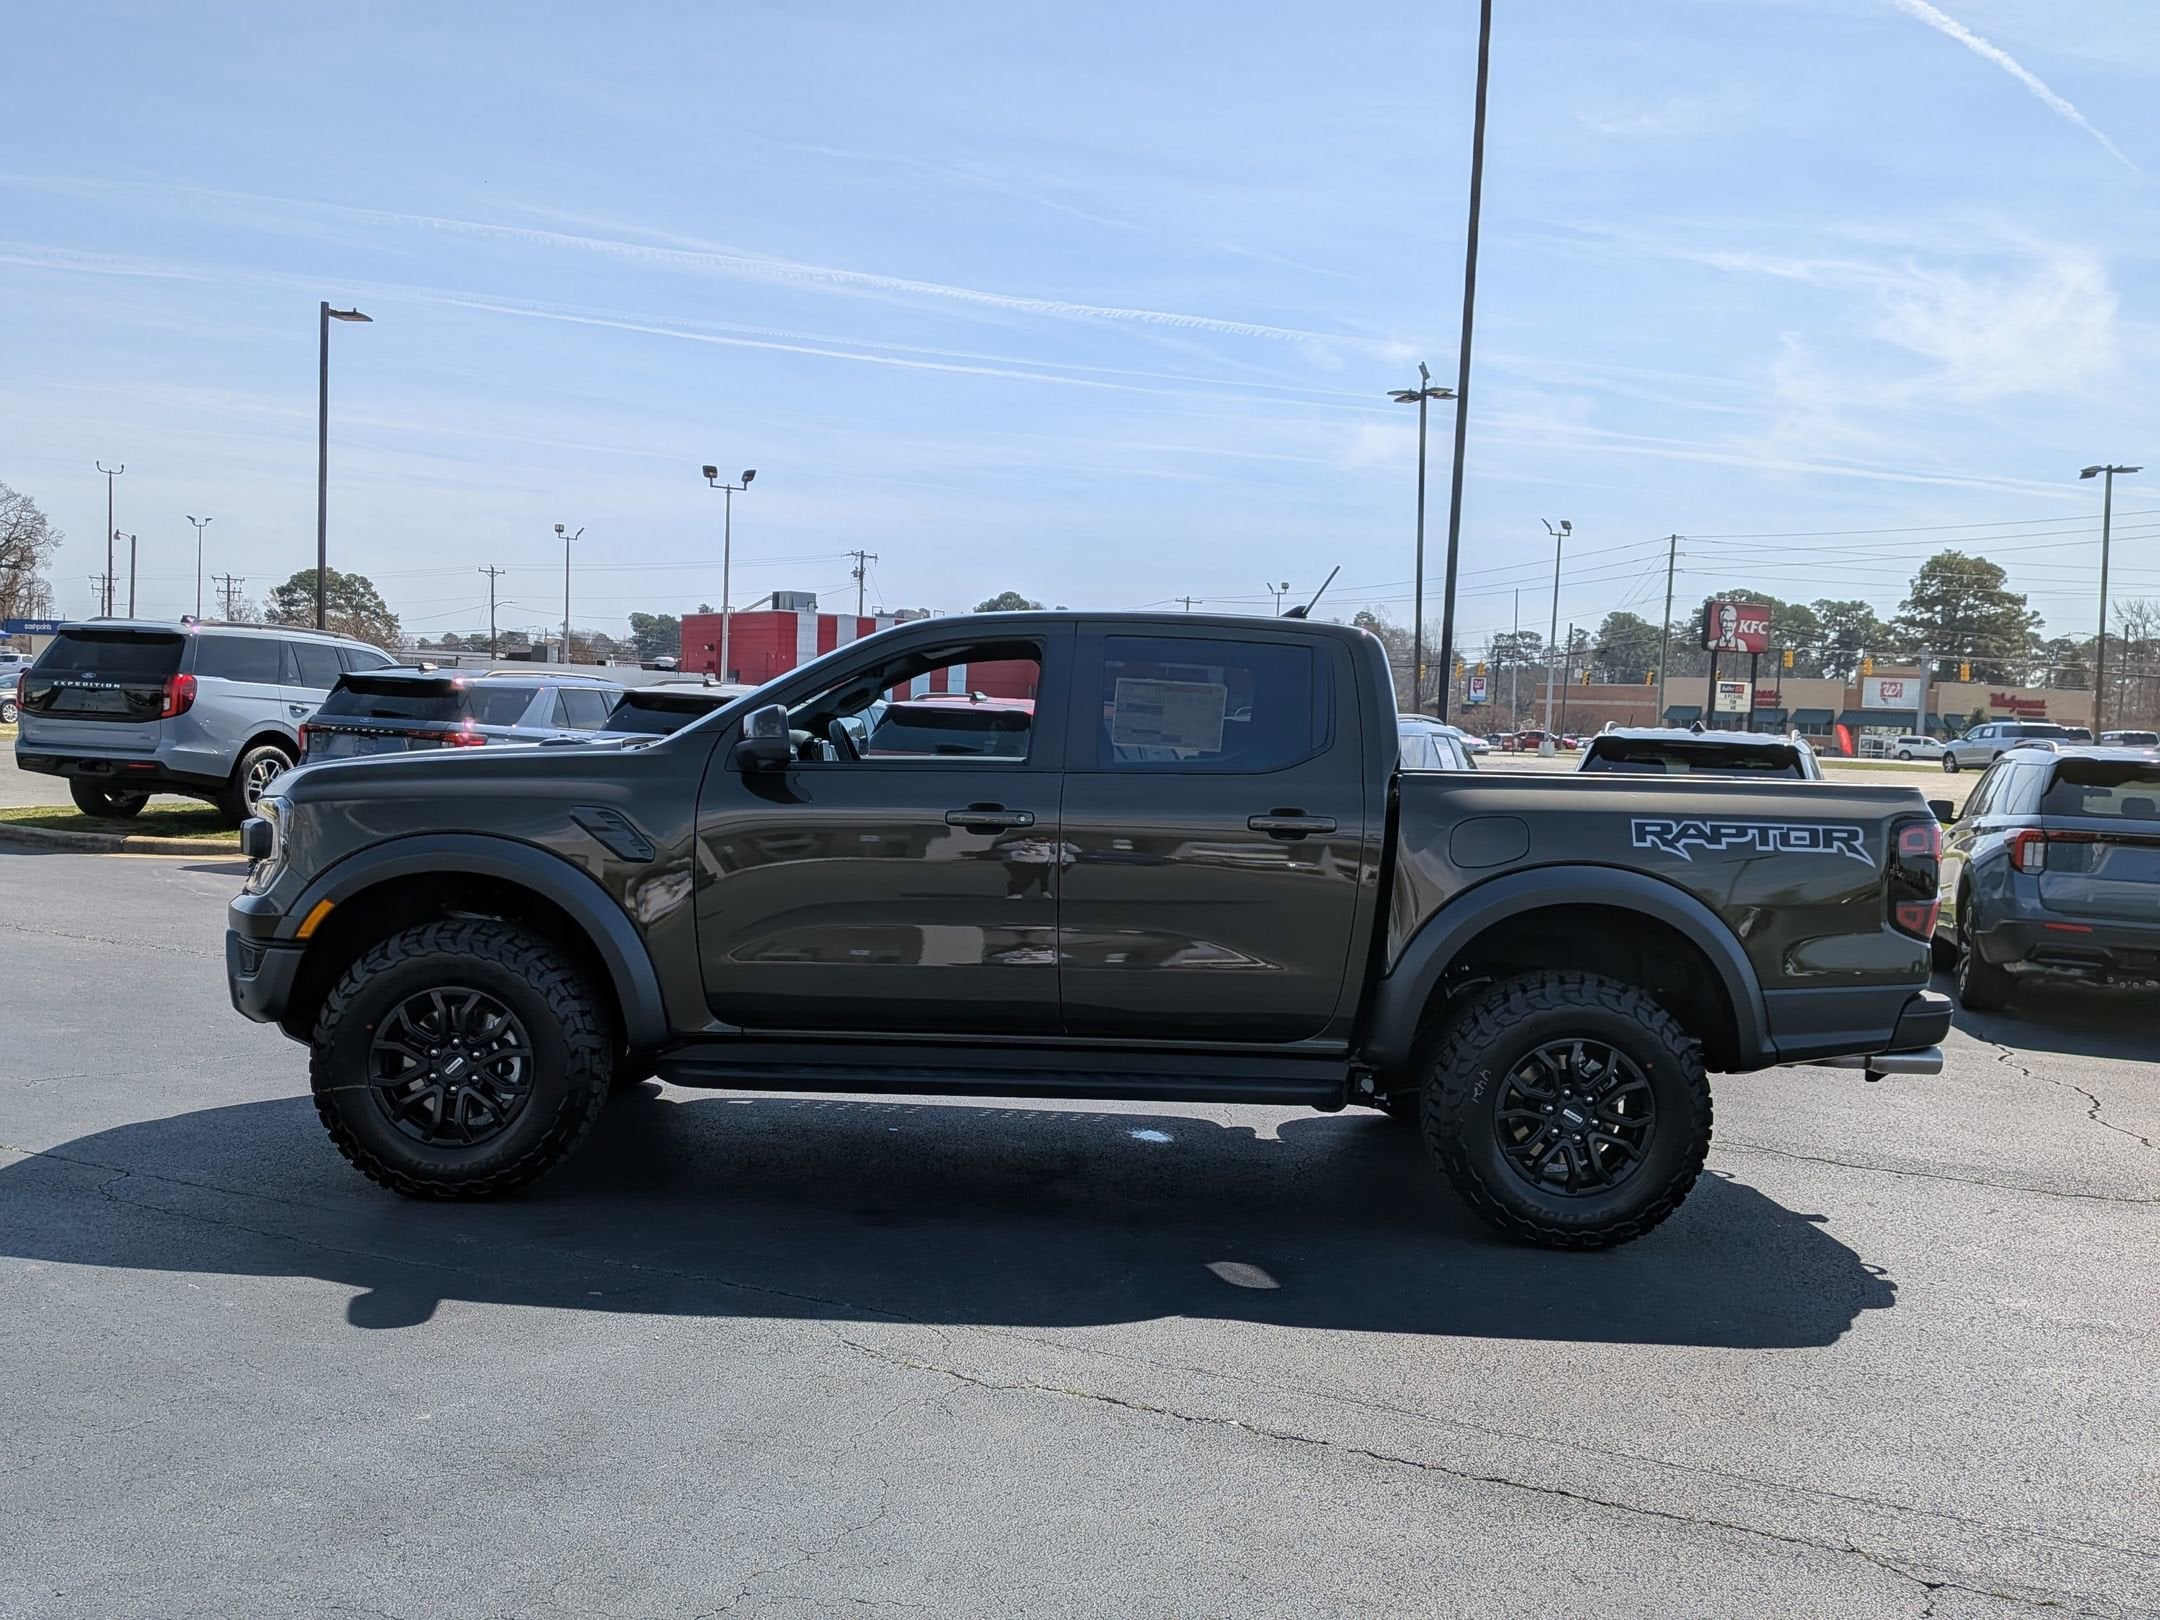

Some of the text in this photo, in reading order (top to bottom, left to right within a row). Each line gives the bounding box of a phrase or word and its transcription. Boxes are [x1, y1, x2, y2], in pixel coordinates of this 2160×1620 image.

[1738, 619, 1769, 635] KFC
[53, 680, 121, 689] EXPEDITION
[1631, 818, 1876, 868] RAPTOR
